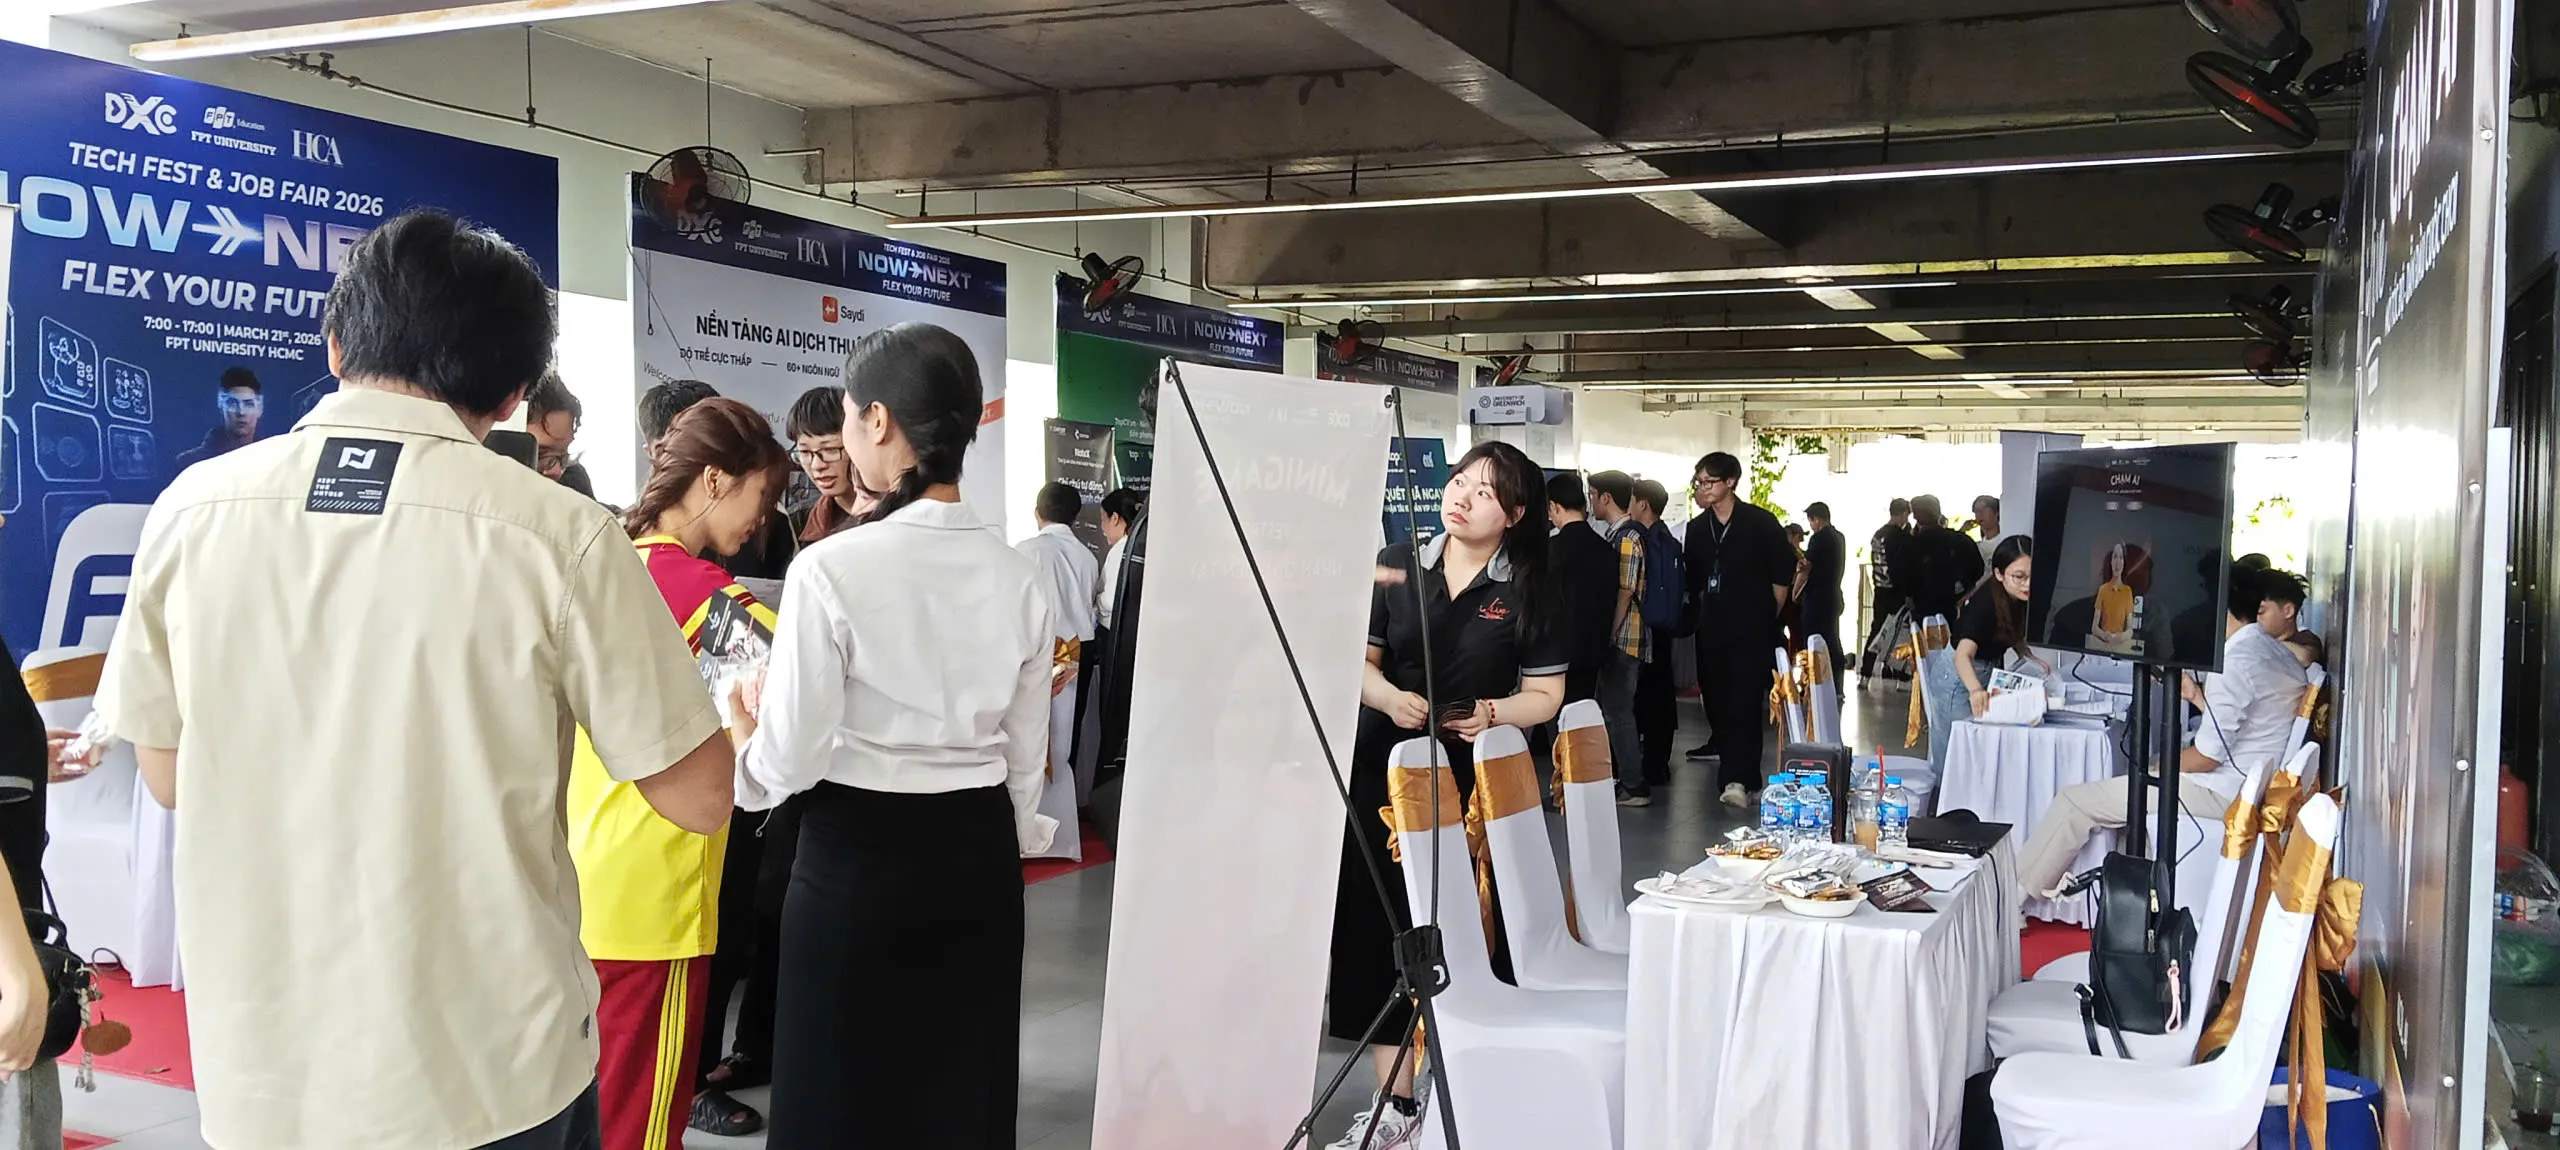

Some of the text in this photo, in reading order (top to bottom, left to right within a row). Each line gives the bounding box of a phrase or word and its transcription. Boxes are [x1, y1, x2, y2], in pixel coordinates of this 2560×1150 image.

[105, 92, 177, 135] DXC
[204, 106, 266, 131] FPT Education
[191, 131, 277, 156] FPT UNIVERSITY
[291, 129, 343, 166] HCA
[69, 142, 384, 217] TECH FEST & JOB FAIR 2026
[0, 170, 369, 274] OW NE
[749, 245, 788, 260] UNIVERSITY
[796, 237, 830, 266] HCA
[883, 243, 898, 253] TECH
[898, 246, 911, 257] FEST
[915, 251, 926, 260] JOB
[926, 253, 938, 262] FAIR
[858, 250, 972, 290] NOW NEXT
[62, 259, 328, 319] FLEX YOUR FUT
[882, 280, 951, 301] FLEX YOUR FUTURE
[840, 306, 865, 323] Saydi
[143, 316, 172, 331] 7:00
[182, 320, 214, 335] 17:00
[223, 326, 268, 341] MARCH
[294, 333, 322, 346] 2026
[696, 309, 728, 339] NỀN
[732, 316, 773, 344] TẢNG
[776, 327, 790, 347] AI
[792, 332, 826, 353] DỊCH
[1194, 320, 1227, 340] NOW
[1235, 331, 1268, 348] NEXT
[165, 336, 304, 361] FPT UNIVERSITY HCMC
[711, 352, 729, 366] CỰC
[730, 352, 752, 366] THẤP
[786, 364, 840, 378] 60+ NGÔN NGỮ
